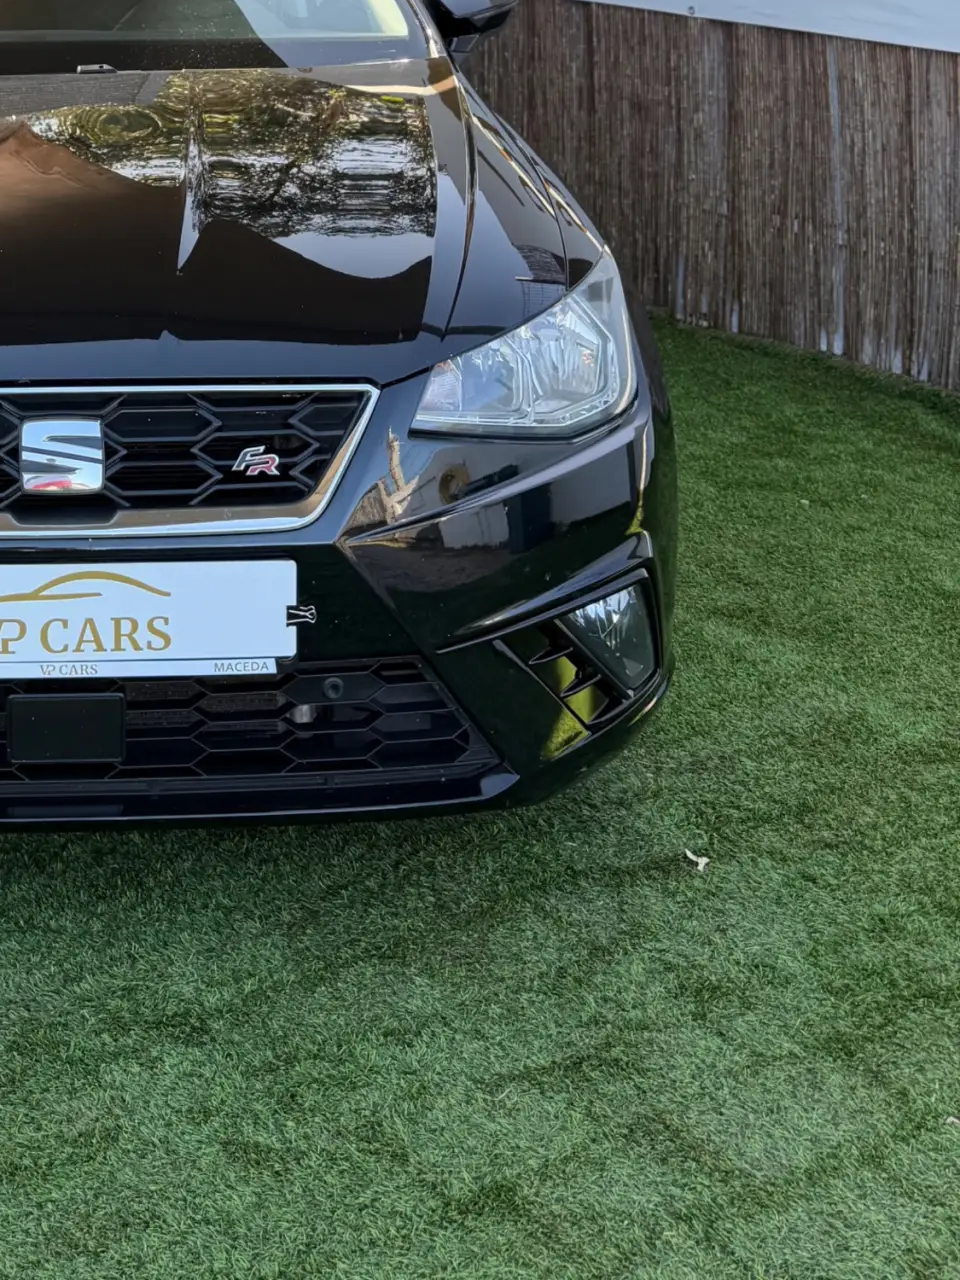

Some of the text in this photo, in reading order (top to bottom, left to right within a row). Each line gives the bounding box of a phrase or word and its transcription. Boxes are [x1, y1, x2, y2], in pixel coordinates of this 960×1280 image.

[231, 445, 280, 475] FR
[40, 616, 172, 654] CARS
[40, 663, 99, 676] VP CARS
[213, 660, 270, 673] MACEDA
